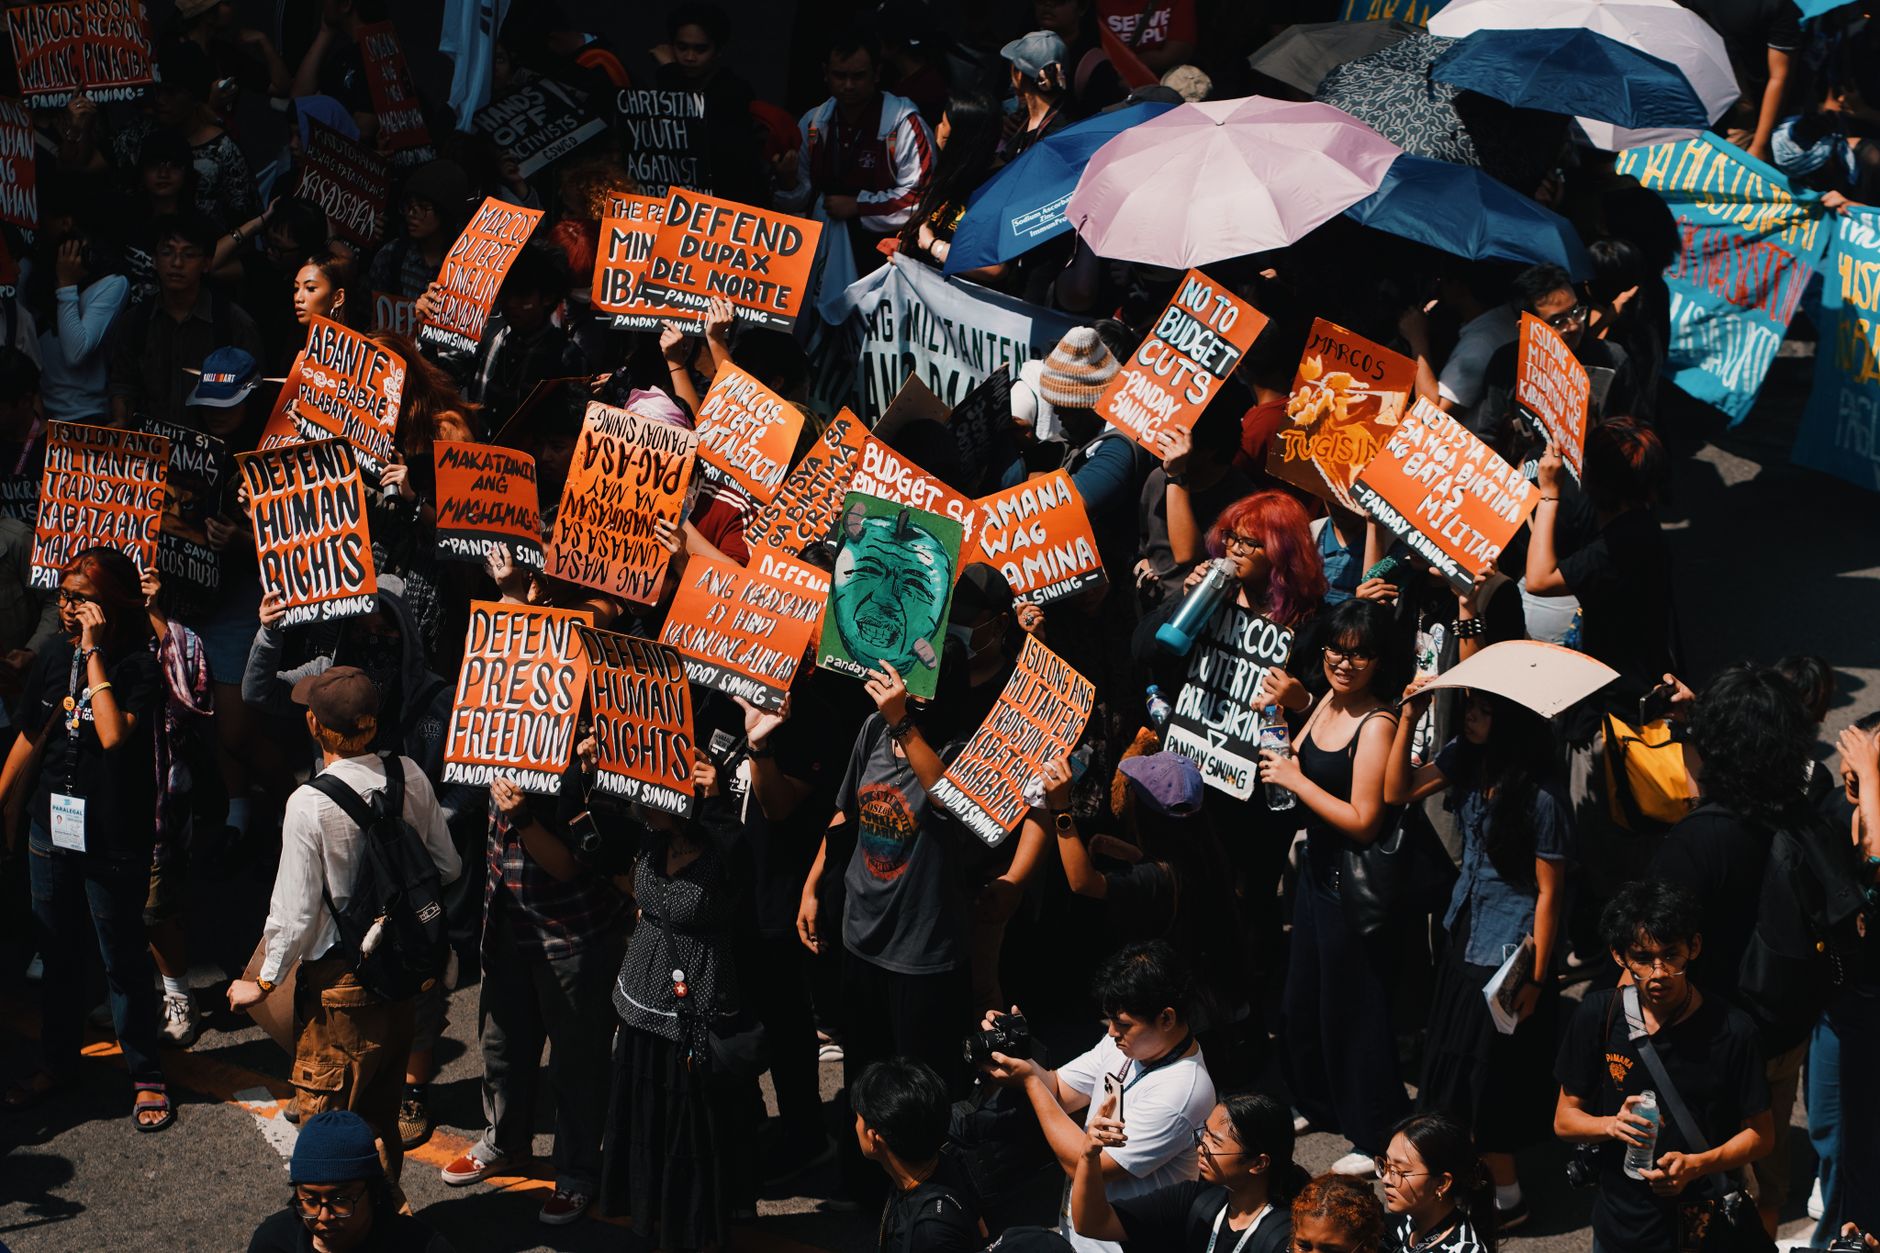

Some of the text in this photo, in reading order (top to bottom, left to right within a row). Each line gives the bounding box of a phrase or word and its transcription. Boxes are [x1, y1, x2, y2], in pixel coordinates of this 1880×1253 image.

[7, 6, 84, 64] MARCOS
[1107, 8, 1171, 33] SEVE
[478, 85, 544, 132] HANDS
[493, 104, 547, 145] OFF
[616, 89, 704, 119] CHRISTIAN
[627, 118, 688, 150] YOUTH
[627, 153, 698, 183] AGAINST
[472, 203, 538, 245] MARCOS
[610, 197, 643, 222] THE
[664, 194, 803, 257] DEFEND
[1014, 211, 1041, 227] Sodium
[1040, 212, 1055, 223] Zinc
[451, 233, 517, 273] DUTERTE
[678, 233, 771, 275] DUPAX
[443, 261, 502, 304] SINGILIN
[650, 256, 793, 310] DEL NORTE
[1178, 276, 1239, 333] NO TO
[450, 331, 479, 354] SINING
[614, 315, 659, 328] PANDAY
[1156, 305, 1240, 375] BUDGET
[304, 323, 390, 397] ABANTE
[1137, 339, 1212, 405] CUTS
[1309, 334, 1386, 380] MARCOS
[299, 383, 348, 423] PALABAN
[335, 376, 387, 422] BABAE
[1109, 390, 1162, 443] SINING
[45, 442, 167, 483] MILITANTENG
[122, 431, 162, 454] ANG
[168, 443, 220, 488] ANAS
[583, 431, 687, 495] PAG-ASA
[244, 438, 358, 500] DEFEND
[471, 476, 508, 494] ANG
[745, 455, 824, 547] HUSTISYA
[824, 419, 852, 450] SA
[786, 442, 859, 523] BIKTIMA
[1386, 436, 1466, 510] NG BATAS
[1397, 418, 1425, 447] SA
[1421, 433, 1458, 471] MGA
[1454, 462, 1521, 524] BIKTIMA
[1483, 455, 1531, 501] PARA
[255, 480, 361, 553] HUMAN
[586, 474, 659, 513] NA MAY
[37, 500, 159, 545] KABATAANG
[560, 517, 661, 568] UMAASA SA
[980, 520, 1048, 560] WAG
[1416, 493, 1501, 565] MILITAR
[259, 532, 367, 605] RIGHTS
[616, 560, 668, 599] ANG
[694, 566, 739, 598] ANG
[1032, 576, 1083, 606] SINING
[322, 594, 375, 621] SINING
[705, 602, 778, 638] AY HINDI
[466, 608, 587, 664] DEFEND
[578, 627, 683, 684] DEFEND
[456, 655, 576, 714] PRESS
[591, 668, 685, 728] HUMAN
[718, 673, 768, 706] SINING
[1021, 637, 1094, 715] ISULONG ANG
[1003, 666, 1086, 747] MILITANTENG
[446, 705, 576, 768] FREEDOM
[594, 712, 691, 783] RIGHTS
[986, 698, 1066, 770] TRADISYON NG
[443, 762, 562, 794] PANDAY SINING
[597, 769, 687, 814] PANDAY SINING
[947, 757, 1025, 826] MAKABAYAN
[1205, 755, 1248, 790] SINING
[52, 805, 83, 816] PARALEGAL
[929, 777, 972, 817] PANDAY
[962, 806, 1005, 843] SINING
